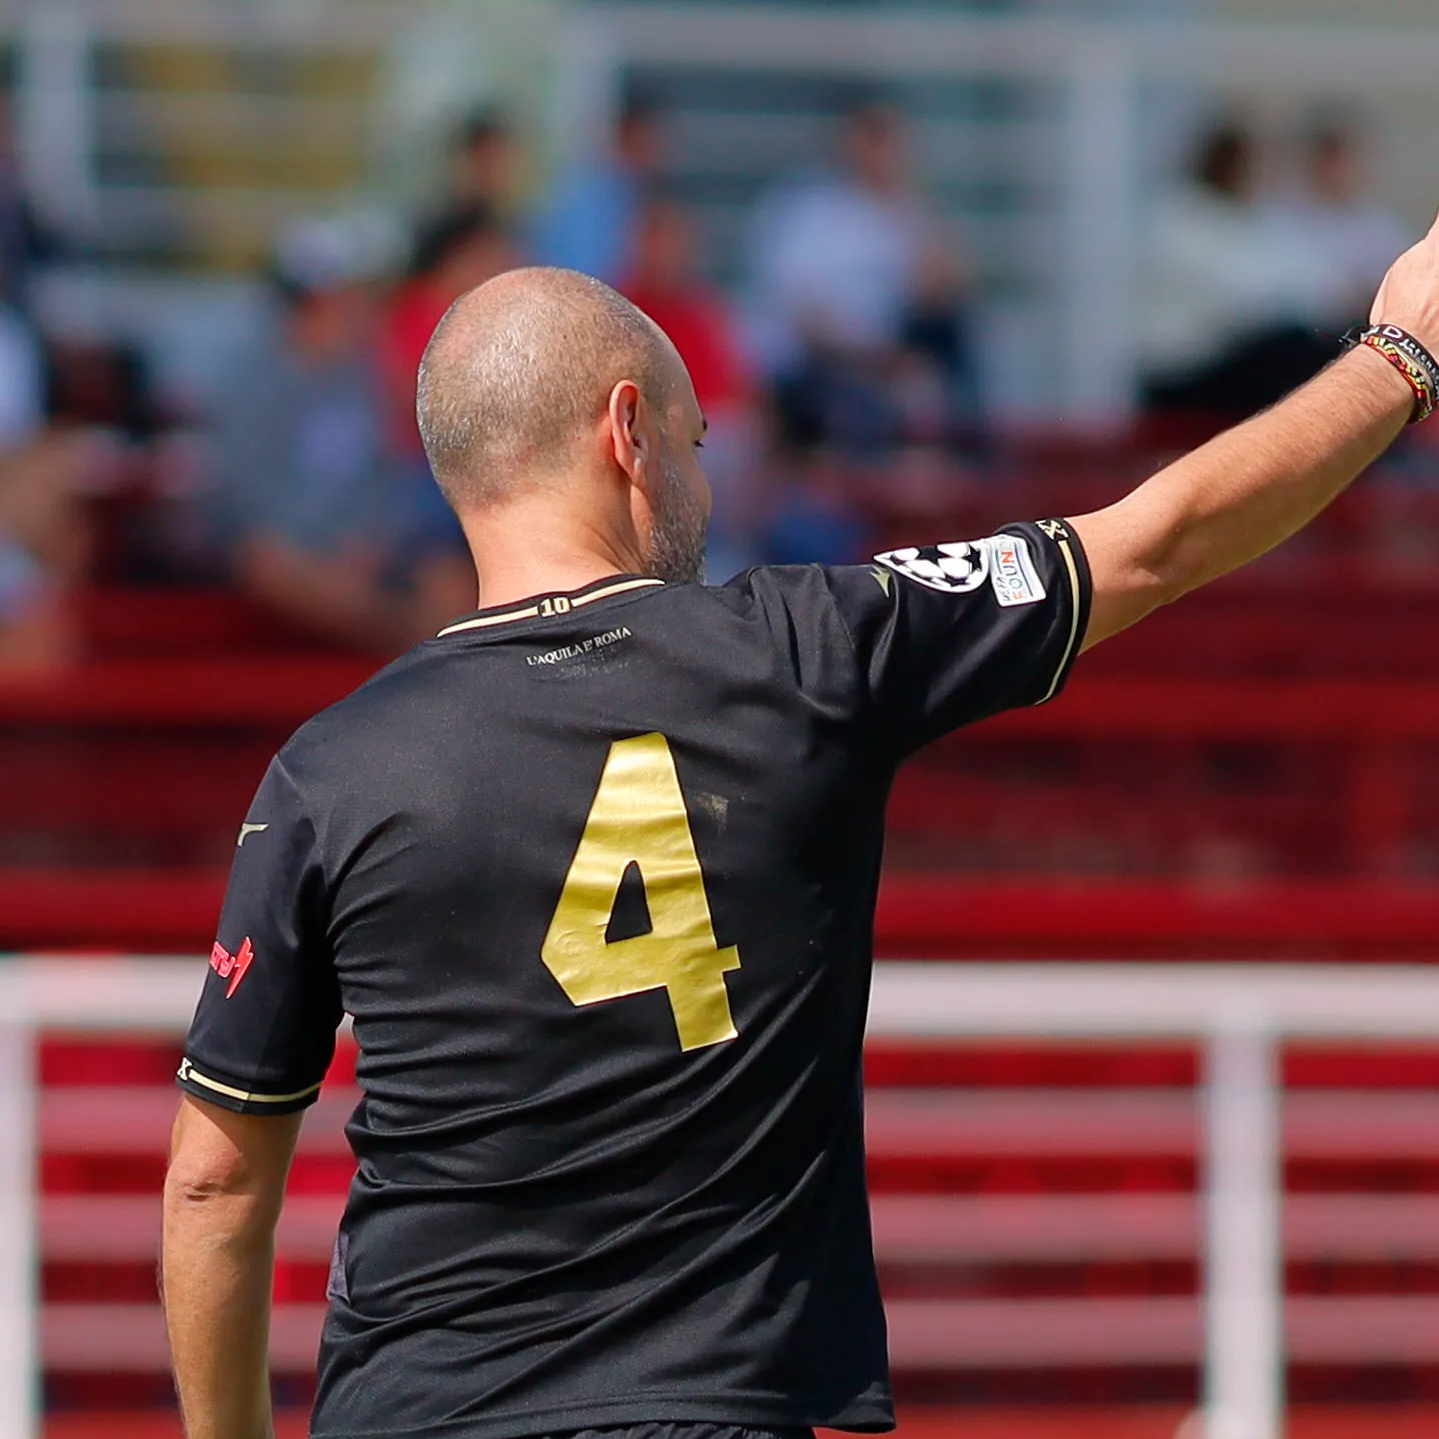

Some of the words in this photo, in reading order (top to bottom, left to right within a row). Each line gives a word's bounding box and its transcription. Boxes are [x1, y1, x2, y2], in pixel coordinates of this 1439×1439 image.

[1001, 548, 1023, 599] FOUN
[541, 596, 571, 617] 10
[593, 626, 631, 647] ROMA
[541, 731, 742, 1052] 4
